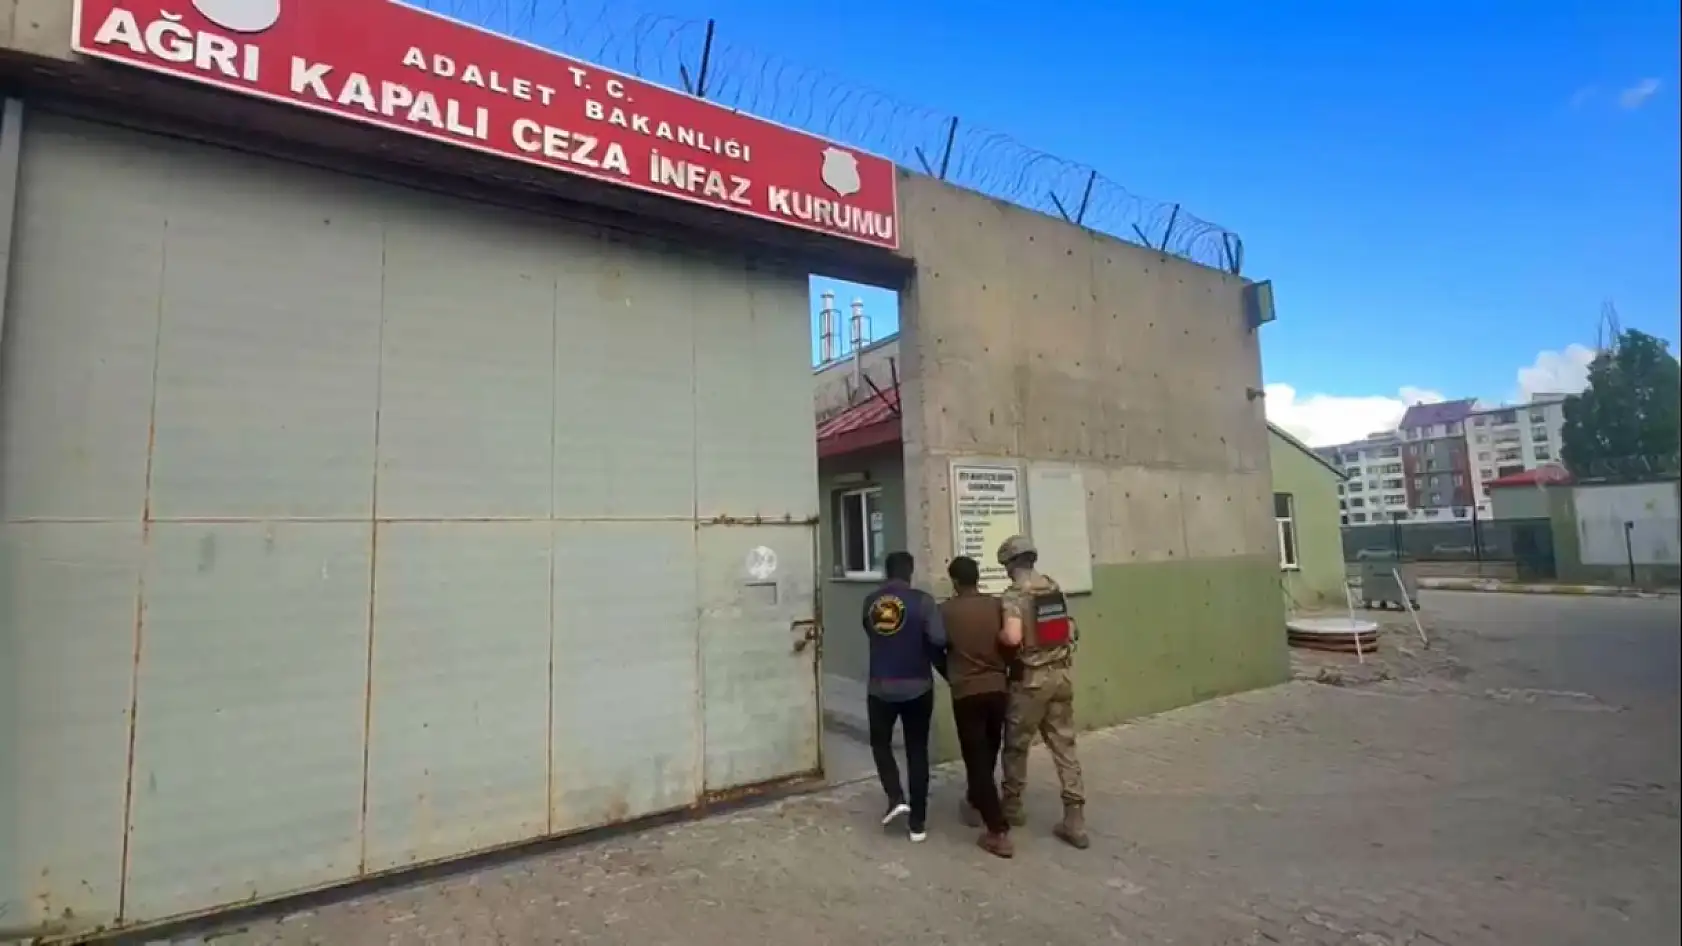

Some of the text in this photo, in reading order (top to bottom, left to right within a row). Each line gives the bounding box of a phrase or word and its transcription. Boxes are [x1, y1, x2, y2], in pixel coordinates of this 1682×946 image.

[93, 7, 892, 239] AĞRI KAPALI CEZA İNFAZ KURUMU
[402, 46, 751, 162] ADALET BAKANLIĞI
